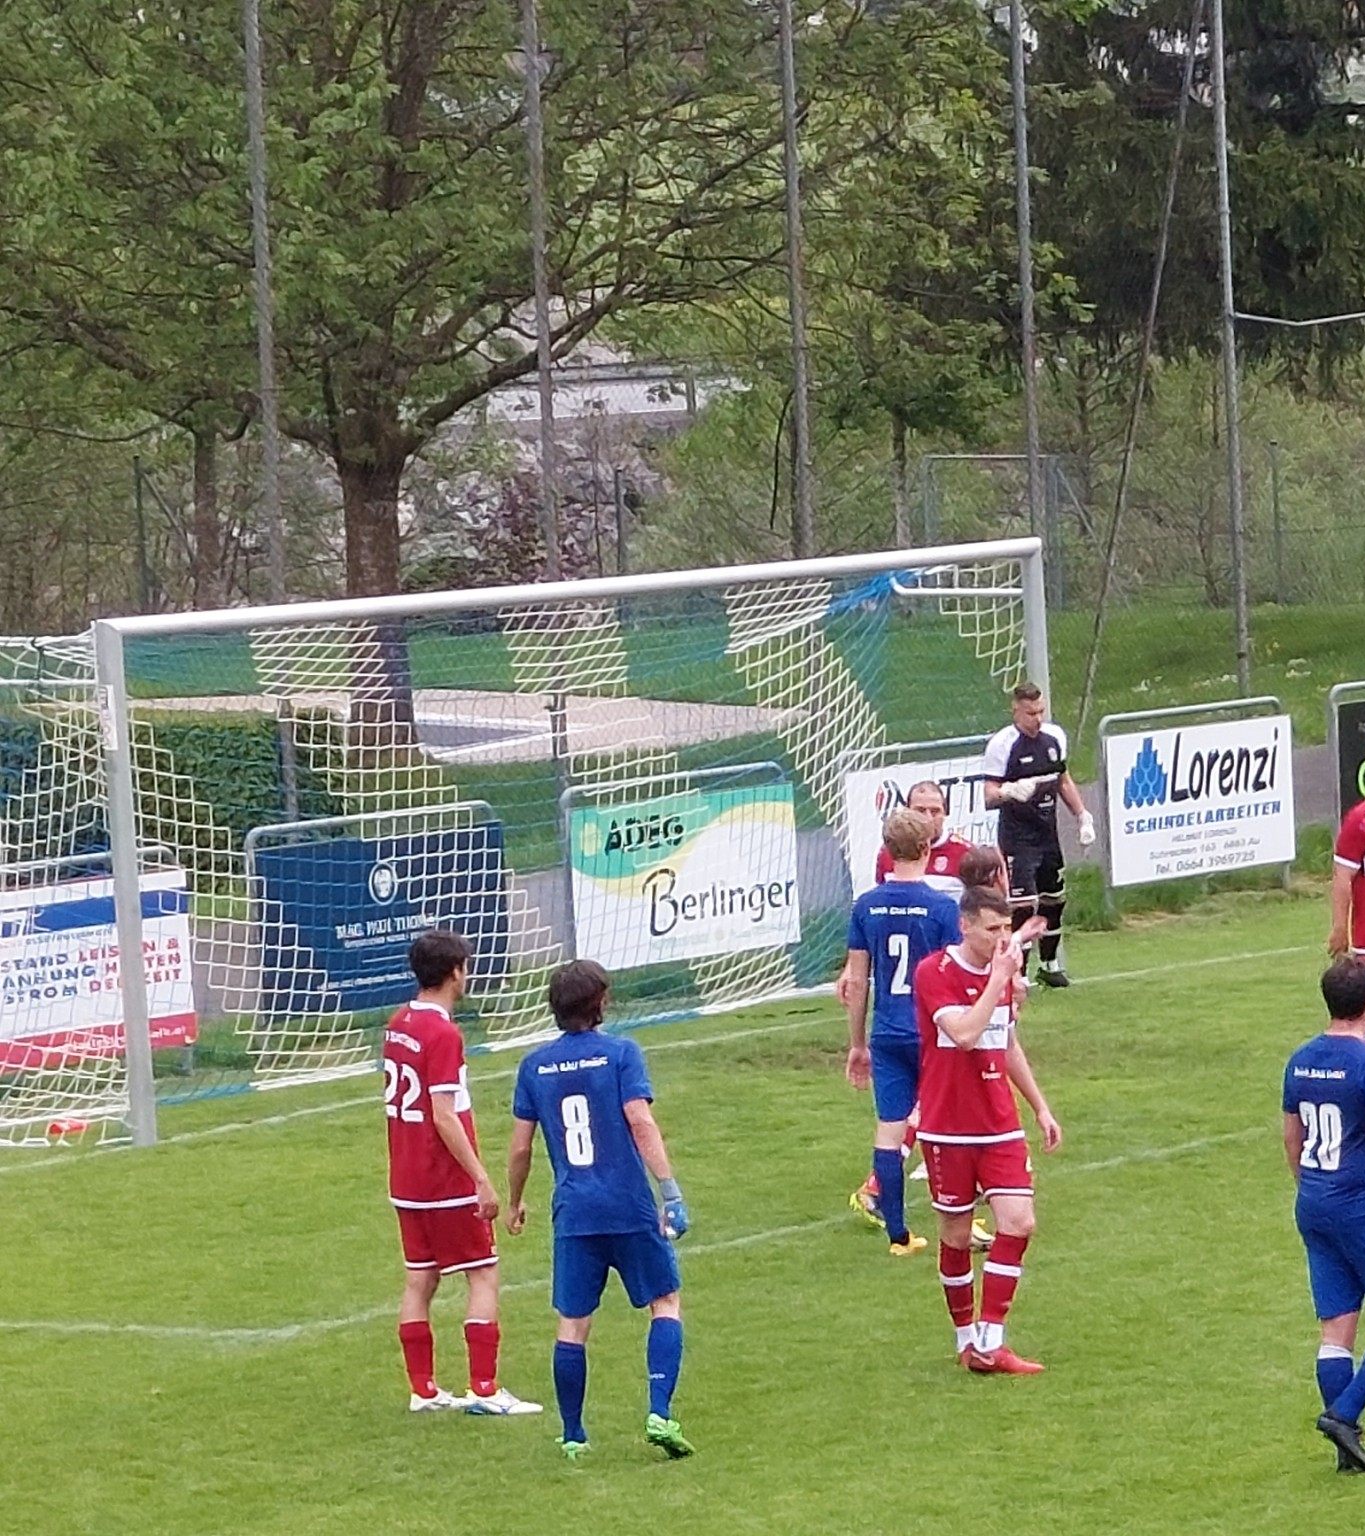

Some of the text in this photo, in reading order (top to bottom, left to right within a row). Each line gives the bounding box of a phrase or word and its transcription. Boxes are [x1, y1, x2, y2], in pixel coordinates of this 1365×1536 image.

[1170, 726, 1279, 803] Lorenzi
[604, 814, 684, 856] ADEG
[1124, 800, 1281, 835] SCHINDELARBEITEN
[1156, 863, 1173, 876] Tel.
[1177, 858, 1204, 872] 0664
[642, 868, 795, 937] Berlinger
[78, 940, 156, 963] LEISN
[106, 952, 181, 974] HTEN
[888, 934, 911, 995] 2
[384, 1058, 425, 1123] 22
[561, 1094, 595, 1167] 8
[1299, 1100, 1343, 1171] 20
